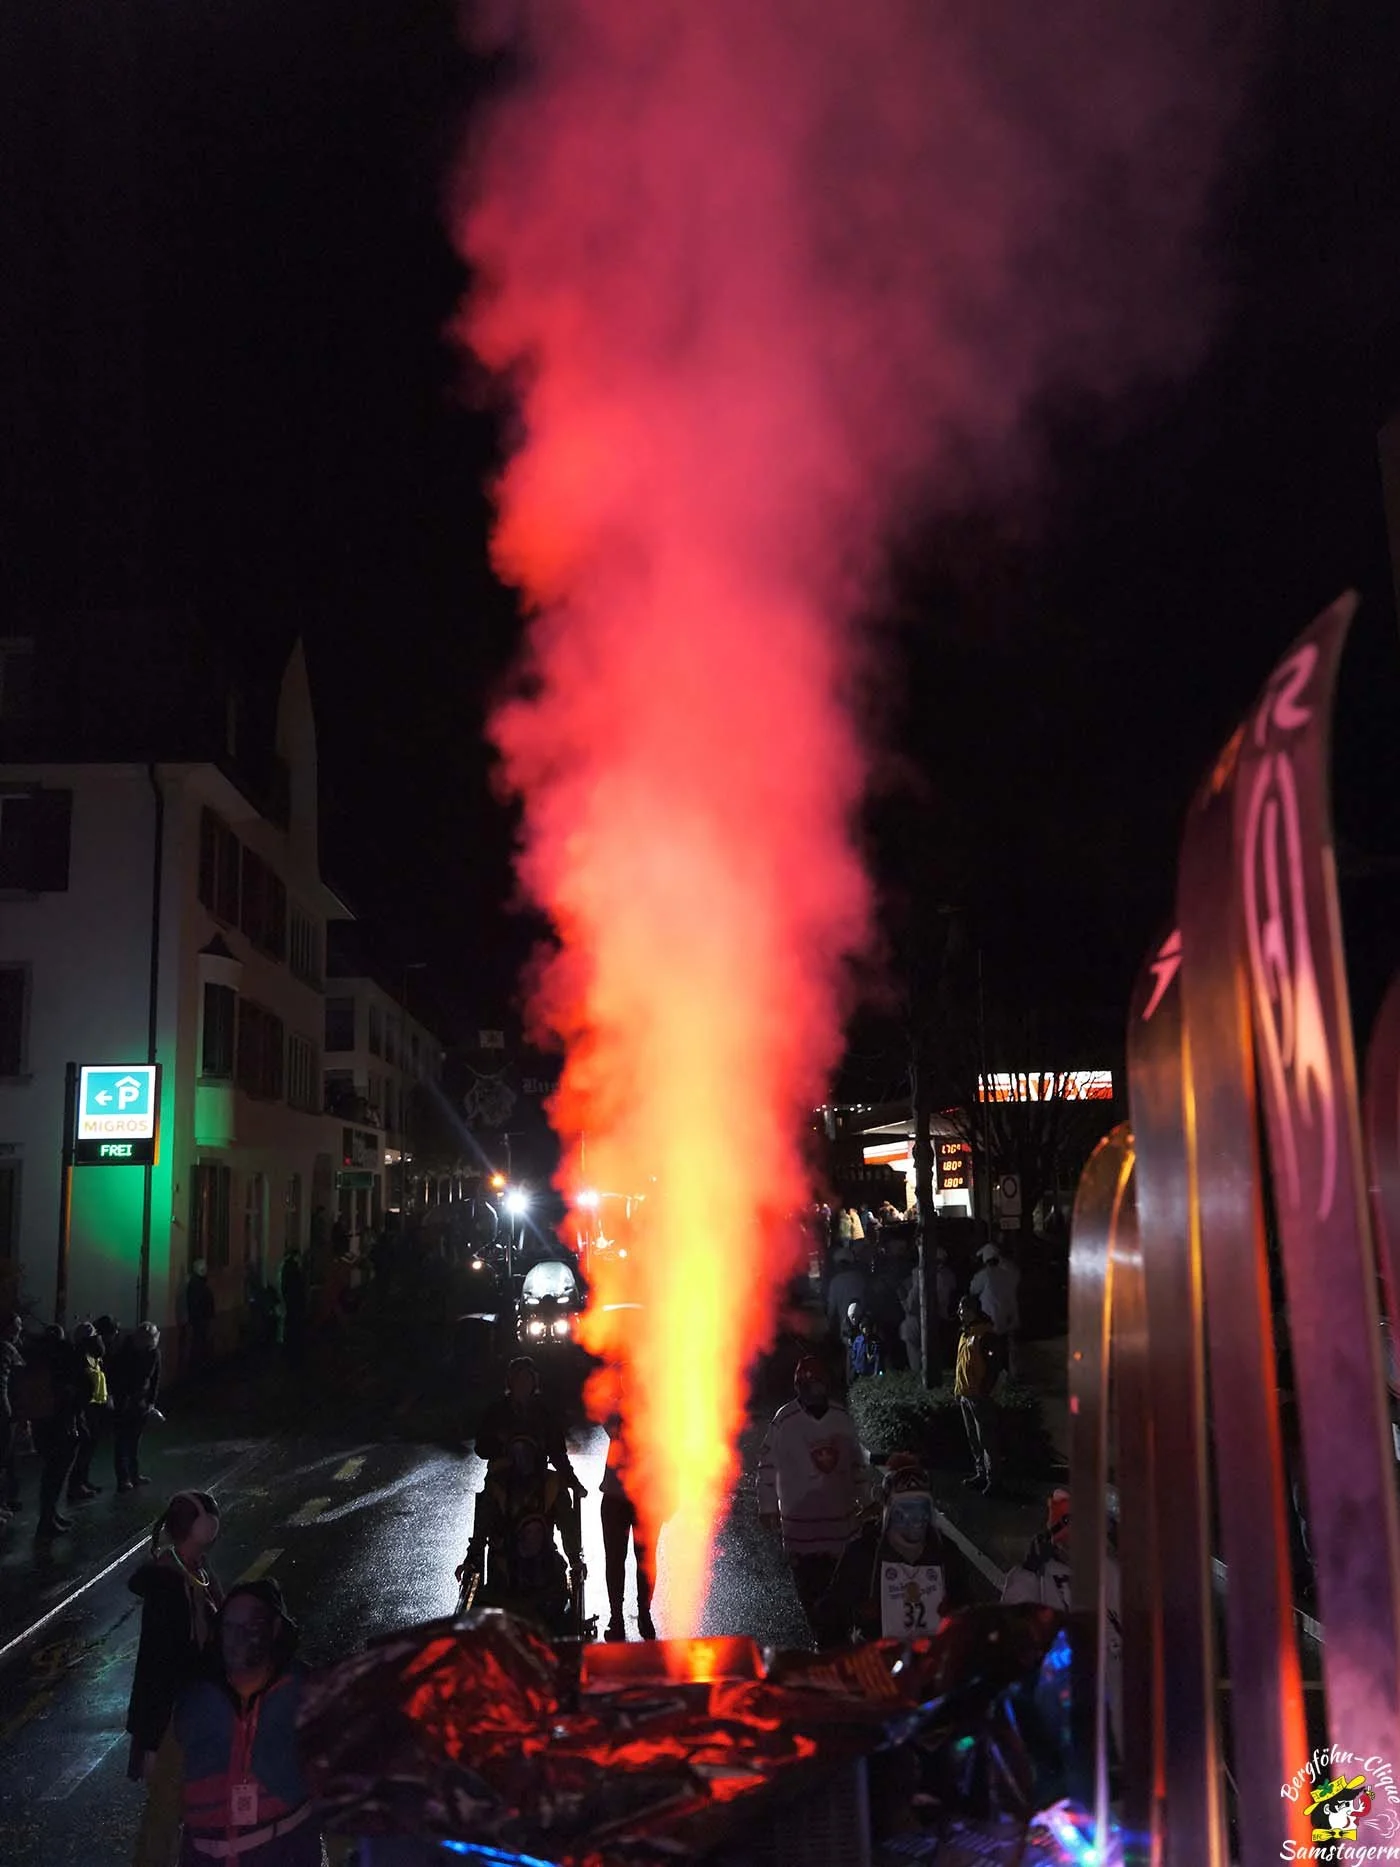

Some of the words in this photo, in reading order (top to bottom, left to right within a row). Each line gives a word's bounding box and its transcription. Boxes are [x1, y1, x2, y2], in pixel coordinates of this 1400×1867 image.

[118, 1086, 140, 1111] P
[84, 1120, 149, 1132] MIGROS
[100, 1144, 133, 1157] FREI
[904, 1602, 927, 1628] 32
